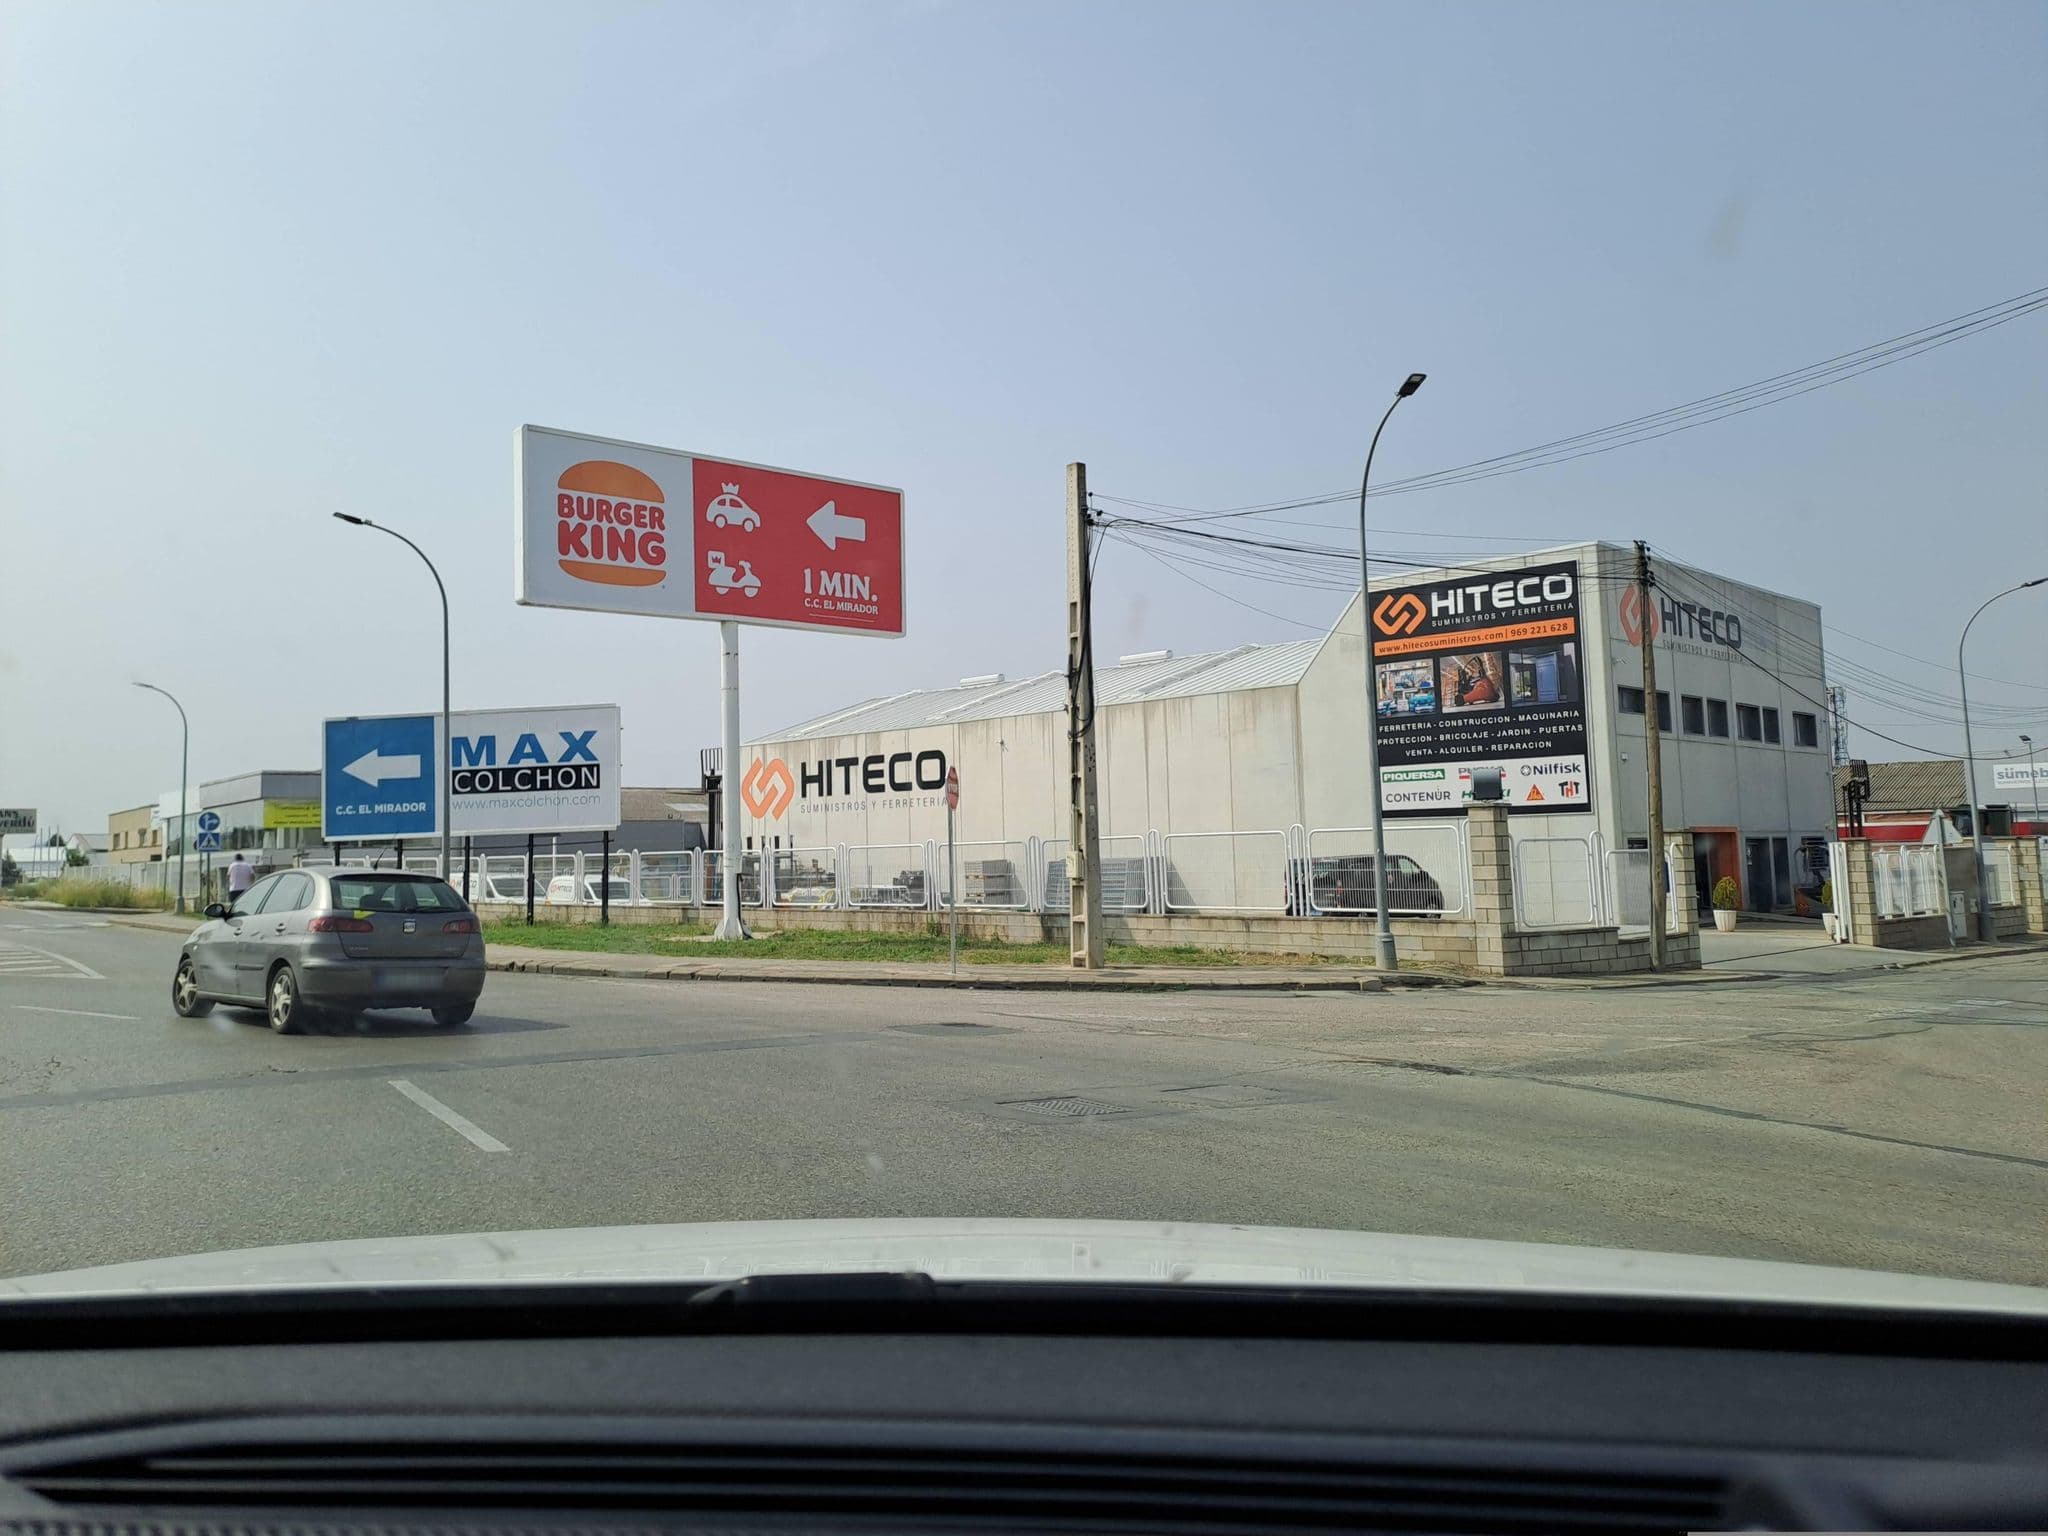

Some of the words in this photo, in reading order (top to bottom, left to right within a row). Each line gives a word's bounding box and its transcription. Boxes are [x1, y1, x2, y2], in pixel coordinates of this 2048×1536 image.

[558, 493, 666, 531] BURGER
[557, 519, 667, 566] KING
[804, 568, 812, 594] 1
[818, 570, 879, 602] MIN.
[1431, 573, 1573, 617] HITECO
[804, 598, 822, 609] C.C.
[823, 600, 835, 610] EL
[836, 602, 879, 615] MIRADOR
[1431, 613, 1496, 627] SUMINISTROS
[1511, 602, 1574, 617] FERRETERIA
[1660, 597, 1742, 649] HITECO
[1379, 632, 1504, 653] www.hitecosuministros.com
[1510, 627, 1528, 637] 969
[1530, 625, 1548, 635] 221
[1550, 622, 1568, 632] 628
[1379, 722, 1432, 733] FERRETERIA
[1438, 716, 1510, 728] CONSTRUCCION
[1518, 710, 1580, 722] MAQUINARIA
[1377, 735, 1432, 746] PROTECCION
[1439, 731, 1489, 741] BRICOLAJE
[1496, 728, 1531, 737] JARDIN
[1539, 724, 1583, 734] PUERTAS
[451, 730, 598, 767] MAX
[1405, 748, 1433, 757] VENTA
[1439, 745, 1483, 755] ALQUILER
[1491, 741, 1552, 752] REPARACION
[454, 766, 598, 793] COLCHON
[801, 749, 946, 798] HITECO
[1383, 770, 1444, 781] PIQUERSA
[1533, 762, 1581, 775] Nilfisk
[335, 804, 356, 815] C.C.
[358, 804, 372, 814] EL
[374, 802, 426, 814] MIRADOR
[452, 795, 601, 811] www.maxcolchon.com
[801, 802, 866, 814] SUMINISTROS
[871, 801, 877, 810] Y
[882, 797, 948, 809] FERRETERIA
